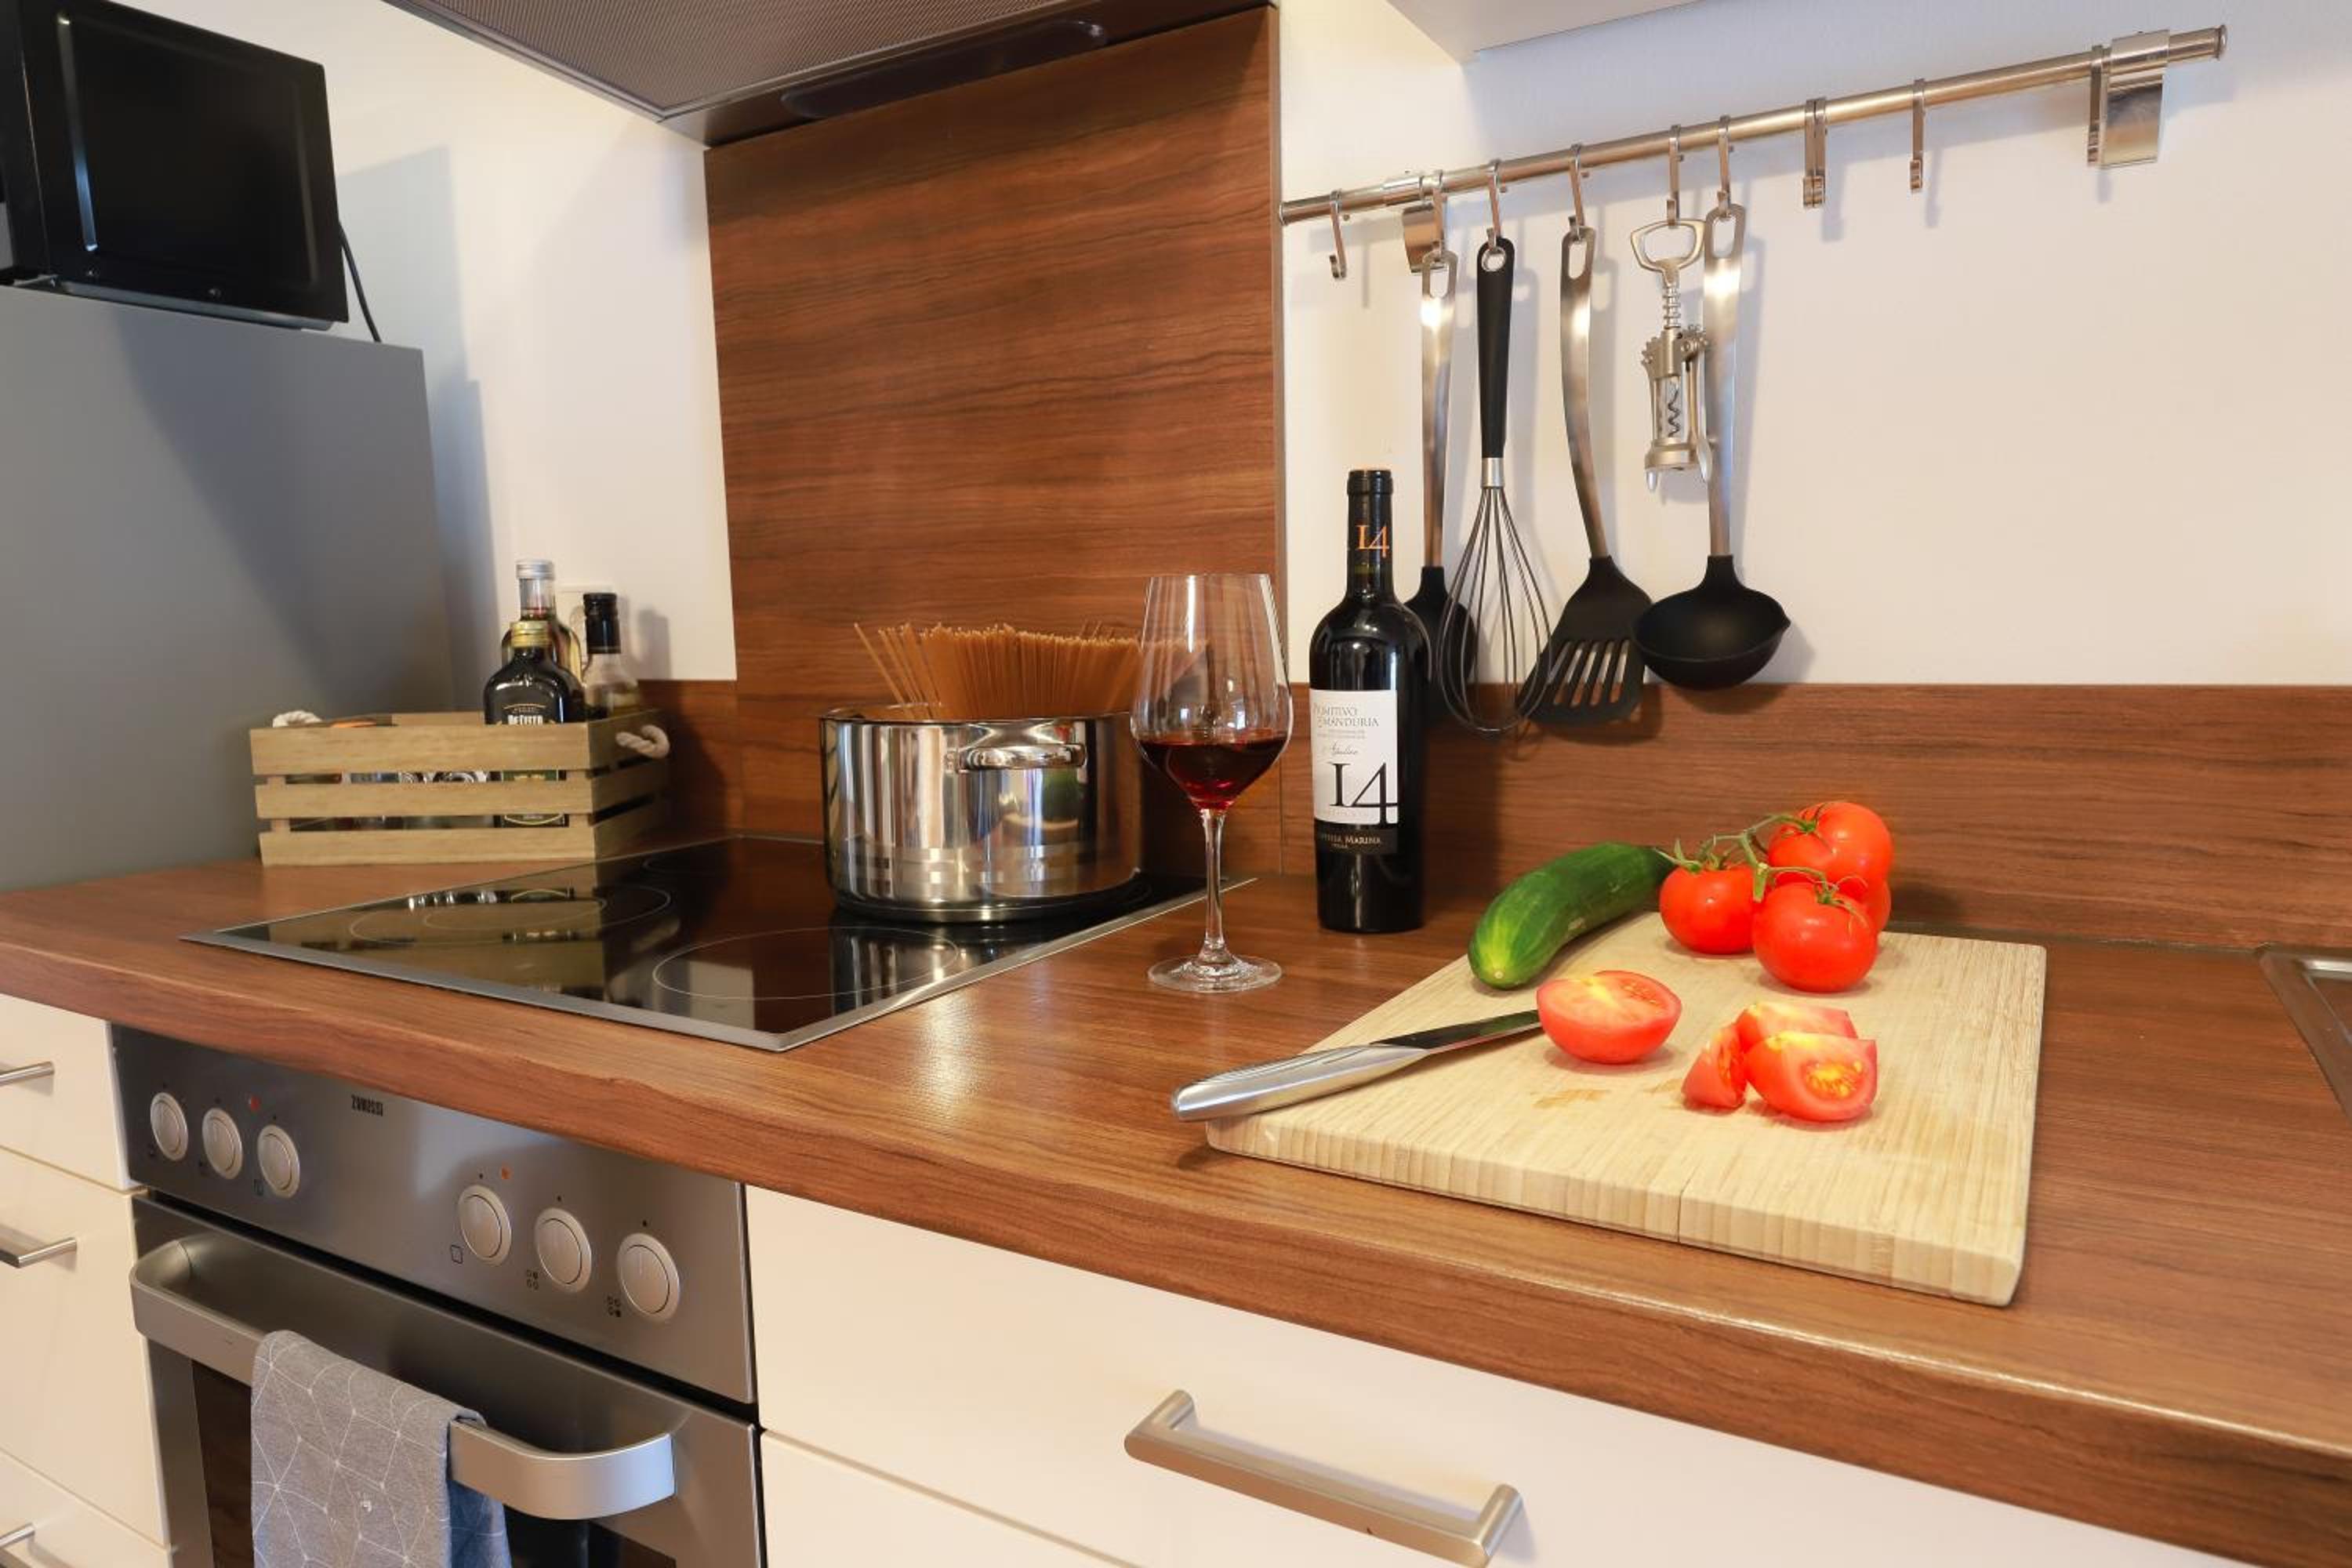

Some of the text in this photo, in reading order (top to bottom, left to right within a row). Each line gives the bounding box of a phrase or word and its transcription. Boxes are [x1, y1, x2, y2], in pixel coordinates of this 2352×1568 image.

[1356, 524, 1389, 557] 14
[1327, 762, 1398, 824] 14
[1345, 835, 1382, 845] MARINA
